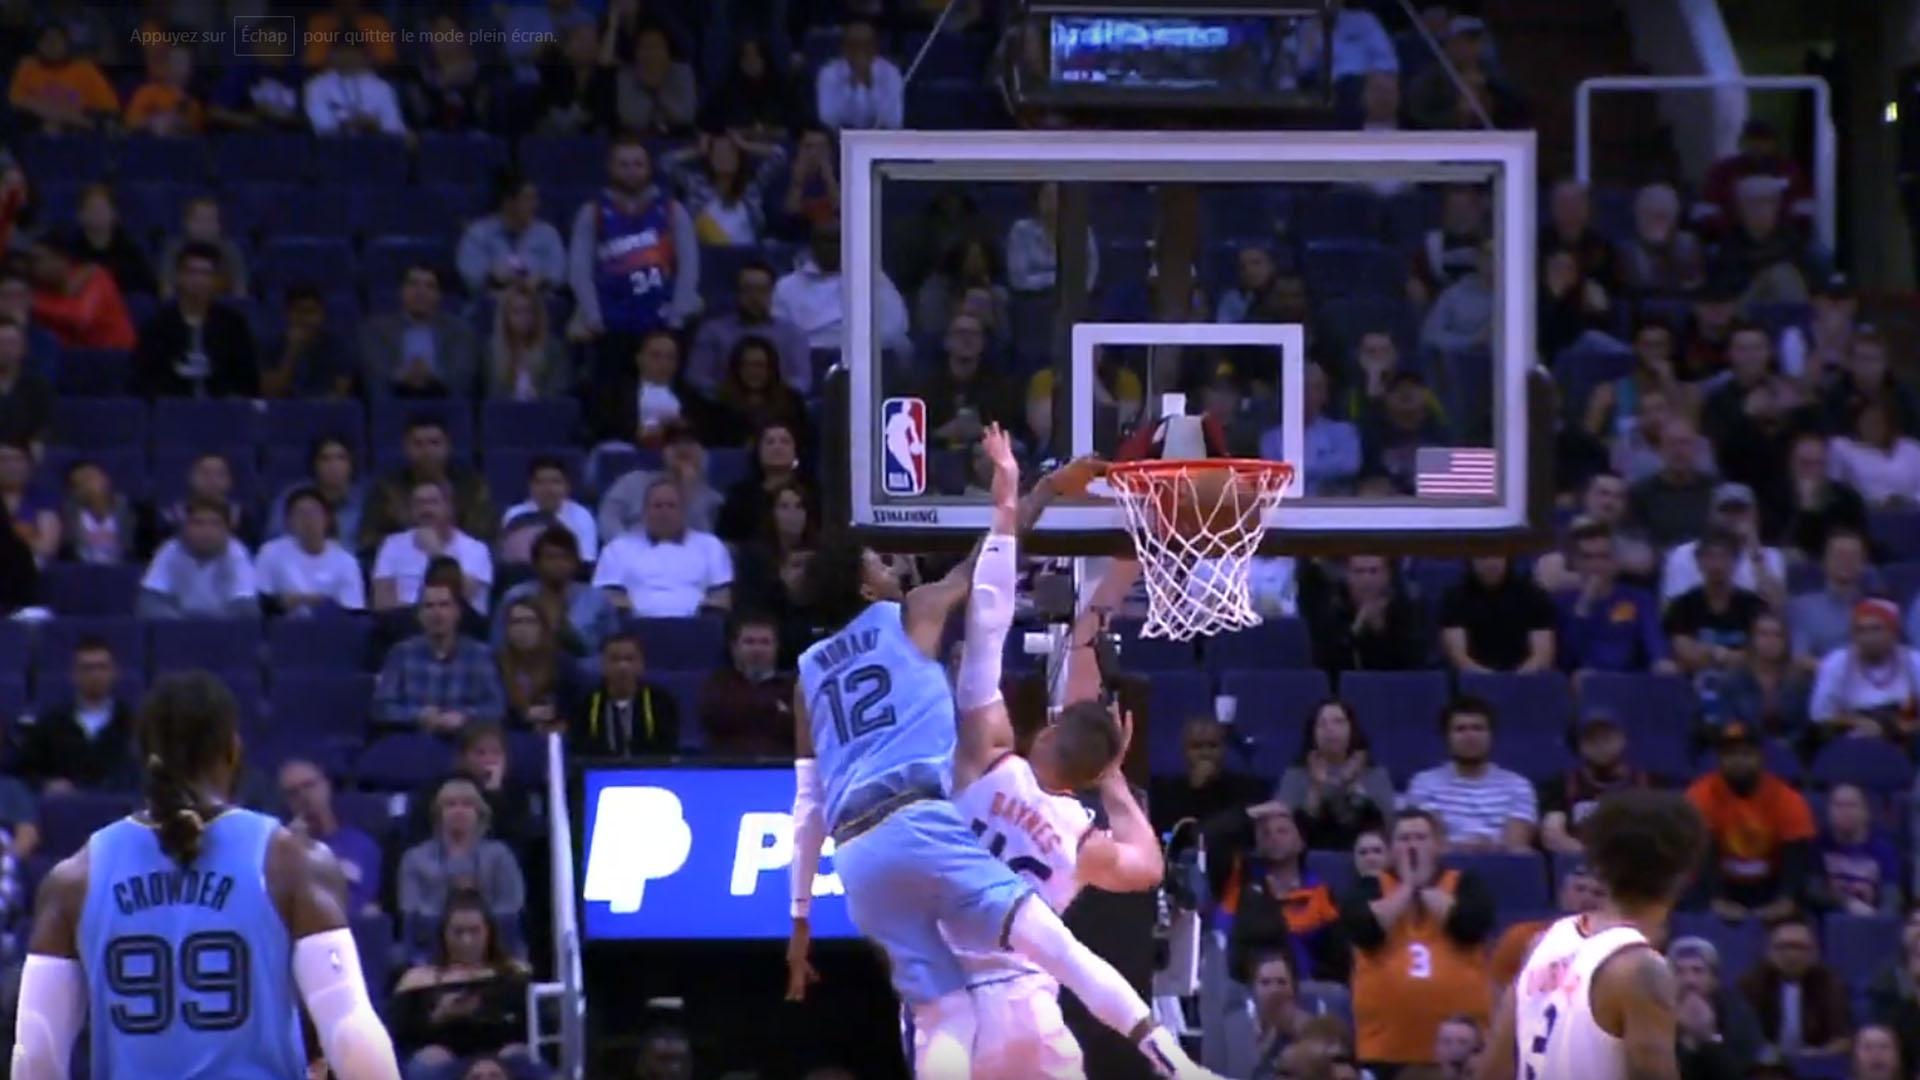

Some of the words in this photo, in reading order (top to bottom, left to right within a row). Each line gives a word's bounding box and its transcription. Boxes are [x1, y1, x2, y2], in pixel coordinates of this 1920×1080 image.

[630, 267, 662, 295] 34
[872, 508, 939, 524] SPALDING
[813, 628, 880, 672] MORANT
[819, 664, 897, 747] 12
[989, 791, 1062, 855] BAYNES
[113, 870, 235, 916] CROWDER
[103, 930, 250, 1036] 99
[1407, 943, 1432, 979] 3
